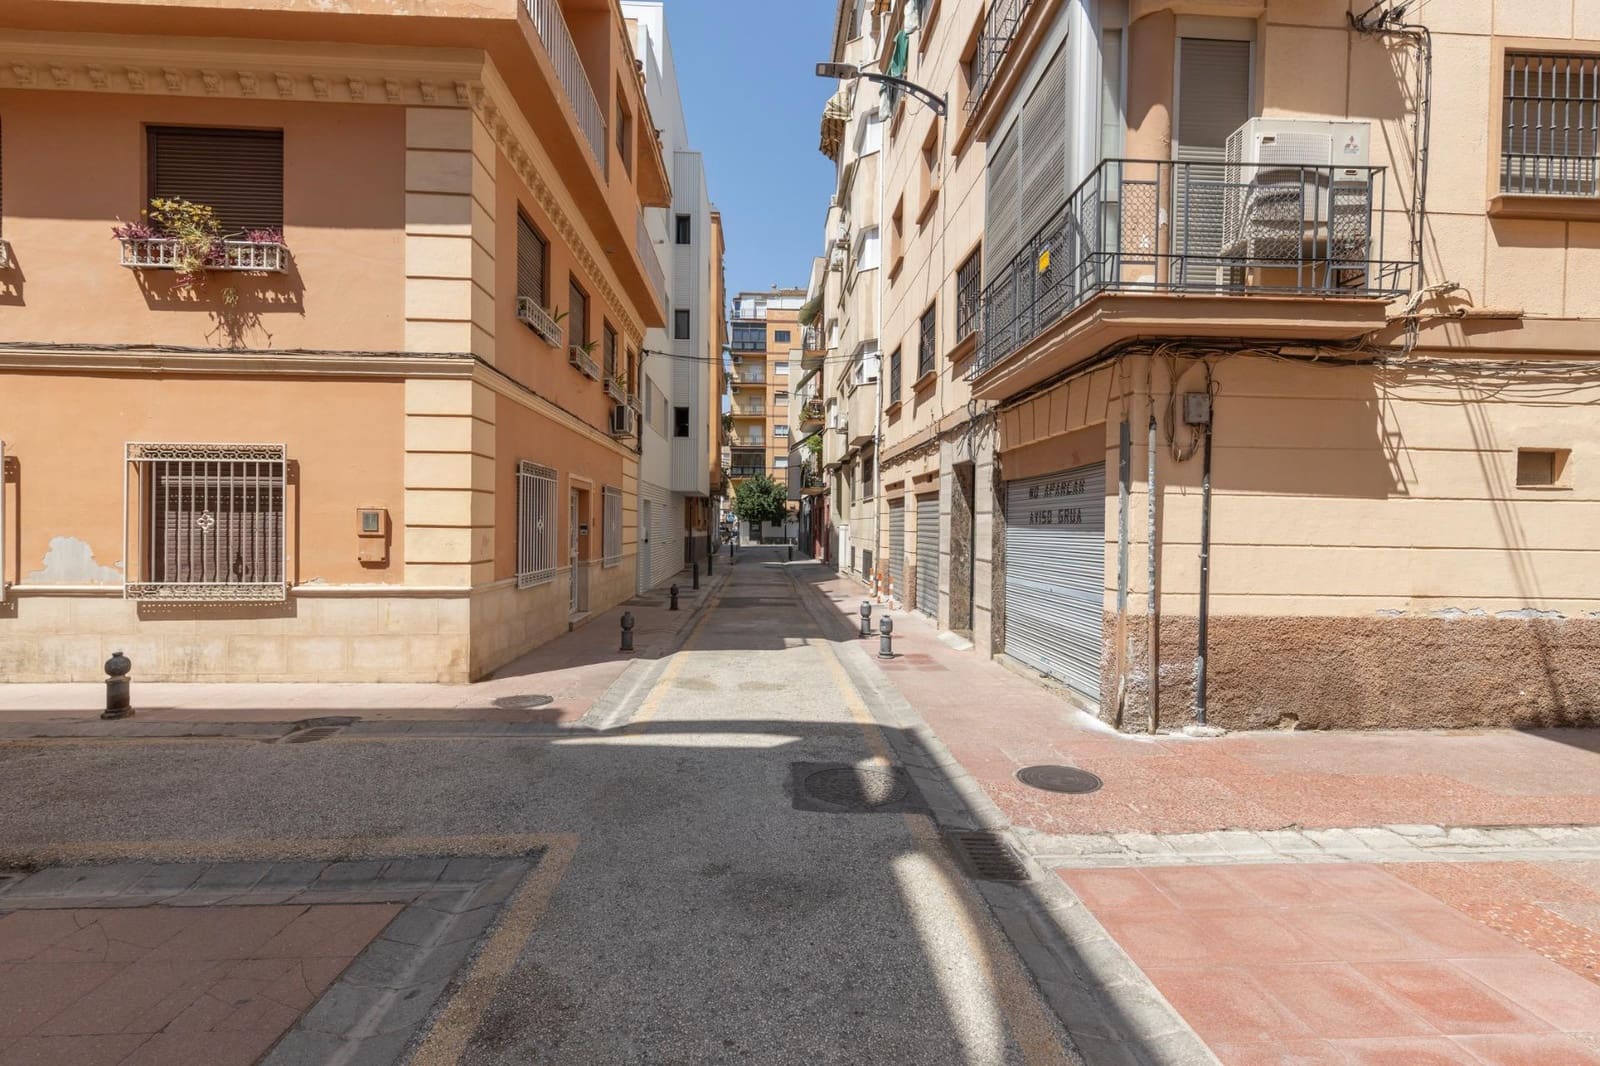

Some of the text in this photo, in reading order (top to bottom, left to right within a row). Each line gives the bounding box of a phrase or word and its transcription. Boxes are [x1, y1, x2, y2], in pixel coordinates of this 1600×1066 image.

[1029, 485, 1039, 499] NO
[1029, 508, 1082, 525] AVISO GRUA
